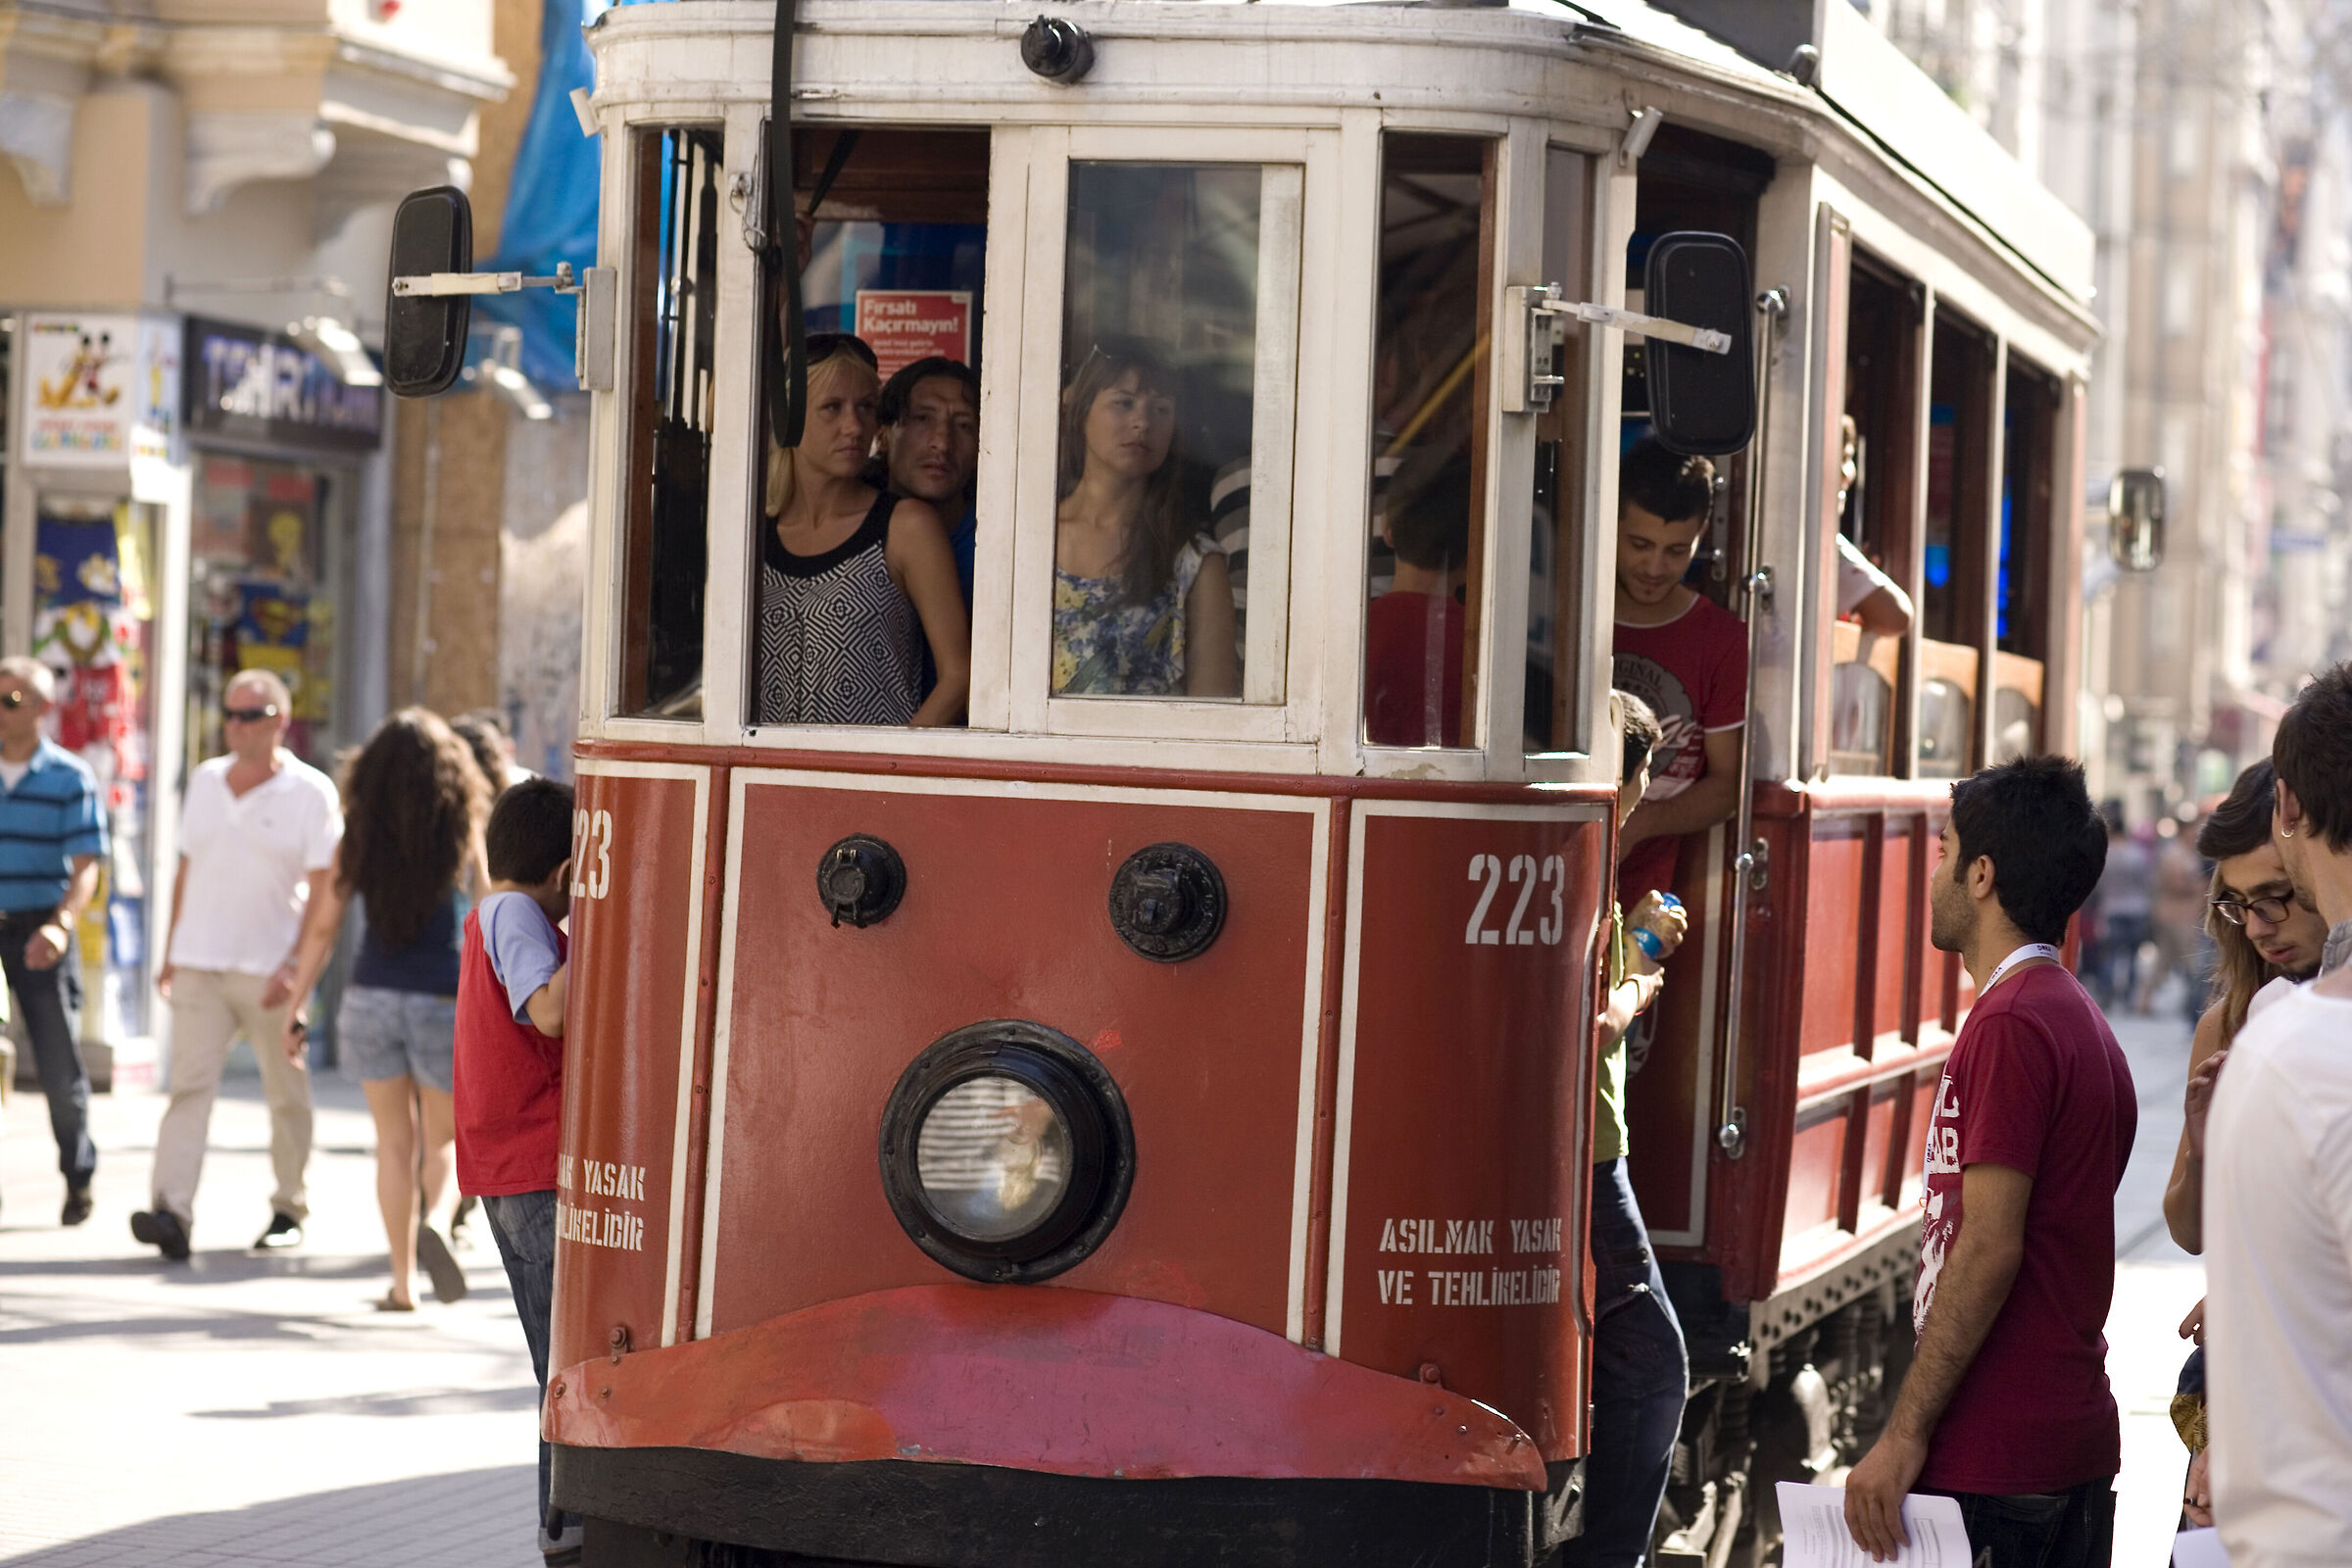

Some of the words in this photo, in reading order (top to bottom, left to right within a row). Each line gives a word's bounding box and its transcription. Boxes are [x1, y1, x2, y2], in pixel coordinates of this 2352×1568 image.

[863, 299, 917, 315] Fırsatı
[863, 317, 959, 336] Kaçırmayın!
[1465, 854, 1565, 946] 223
[583, 1158, 647, 1201] YASAK
[1379, 1217, 1494, 1254] ASILMAK
[1510, 1217, 1562, 1253] YASAK
[1378, 1269, 1414, 1305] VE
